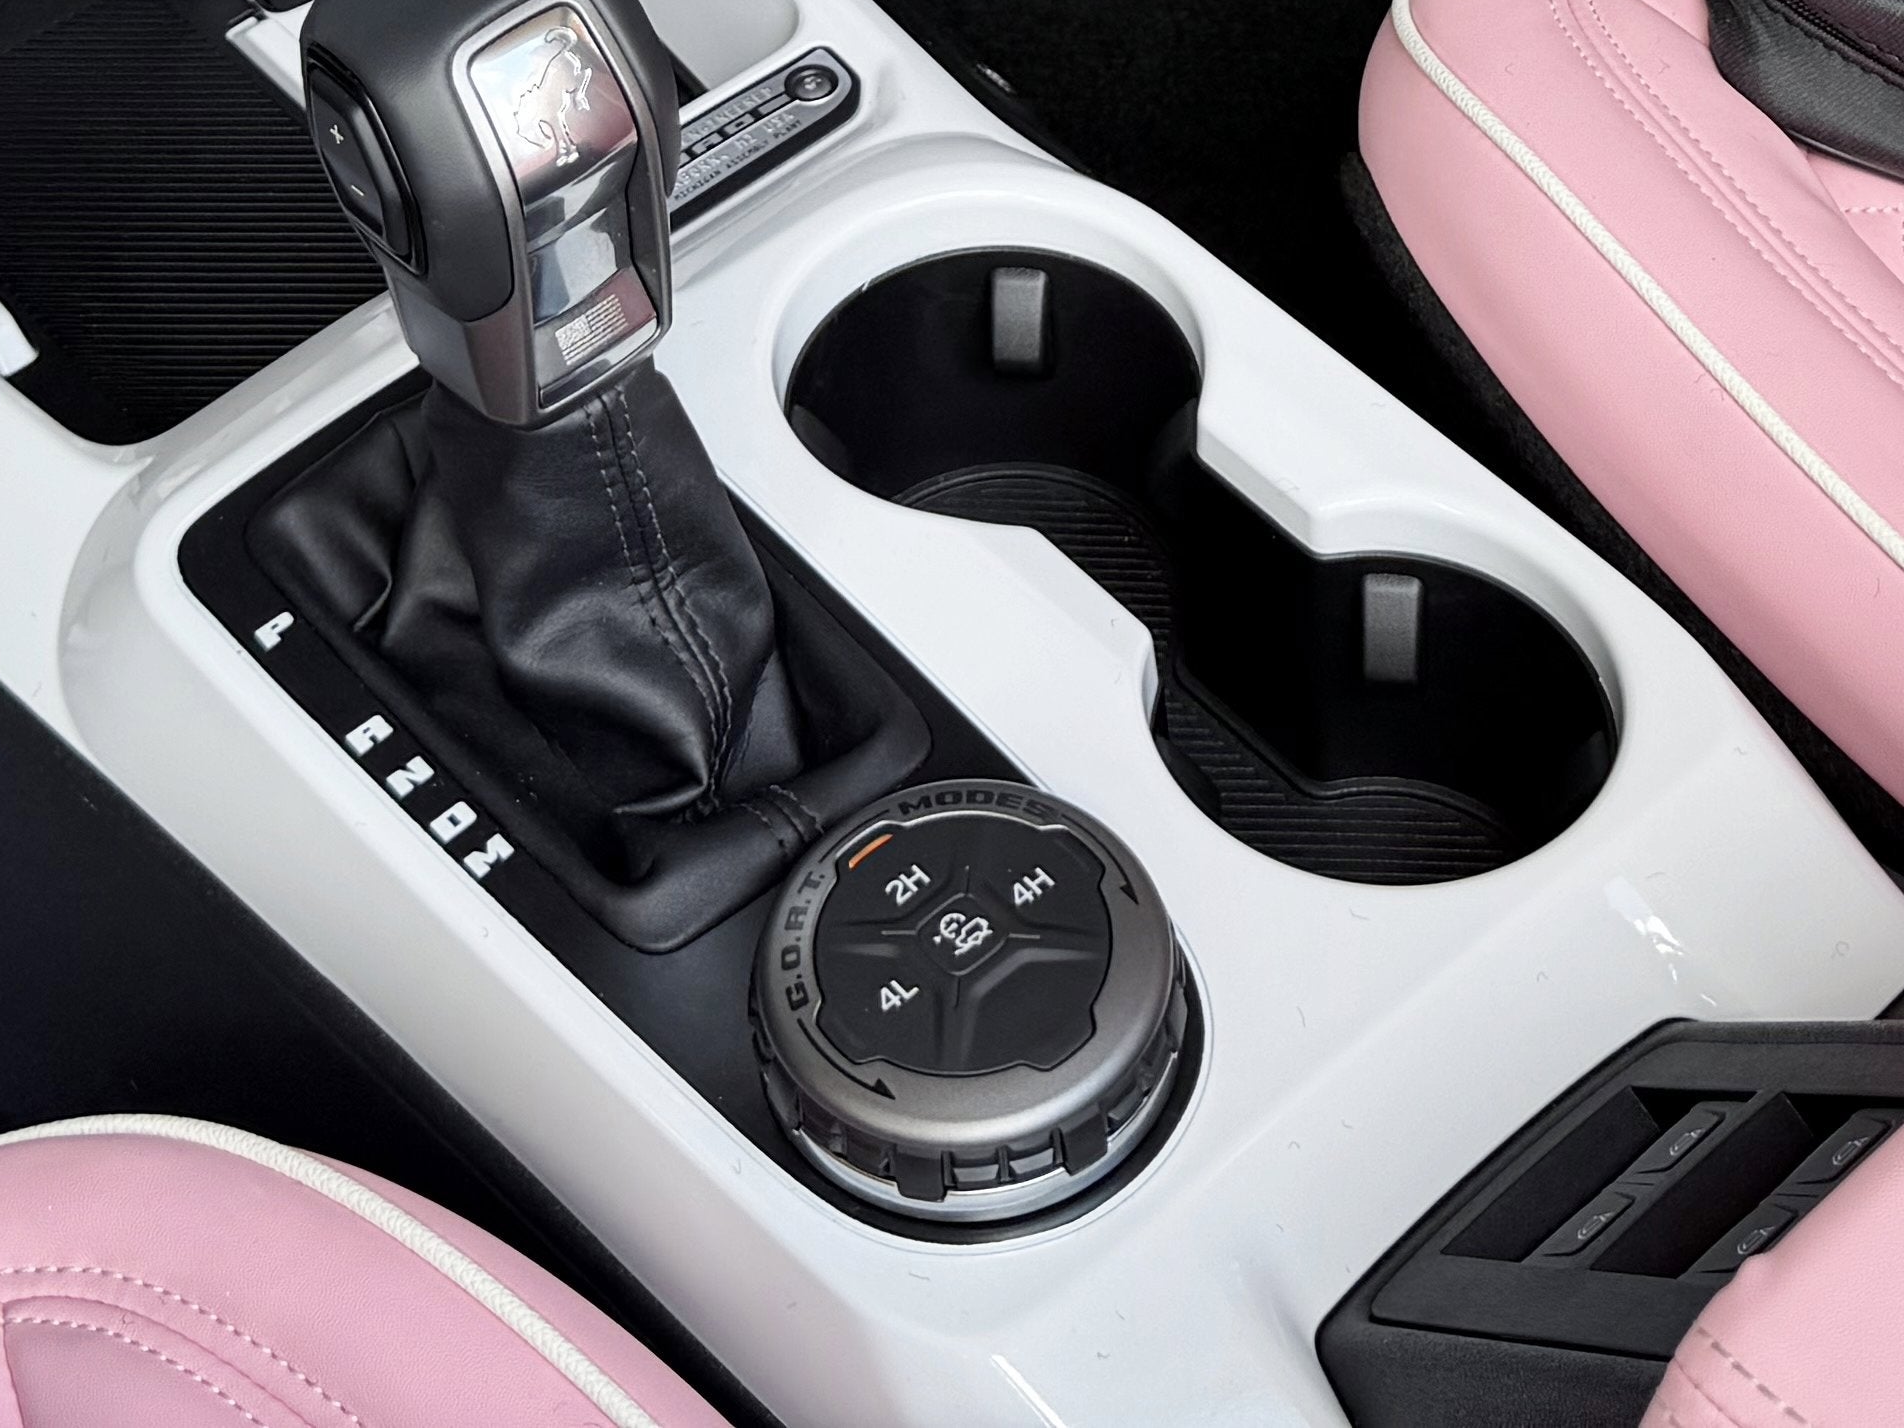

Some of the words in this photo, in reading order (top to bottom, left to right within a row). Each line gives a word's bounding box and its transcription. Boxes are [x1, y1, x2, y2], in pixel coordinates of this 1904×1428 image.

[254, 611, 295, 652] P
[386, 755, 435, 798] N
[898, 789, 1059, 818] MODES
[463, 833, 515, 878] M
[885, 863, 932, 906] 2H
[1012, 867, 1055, 907] 4H
[879, 979, 919, 1012] 4L
